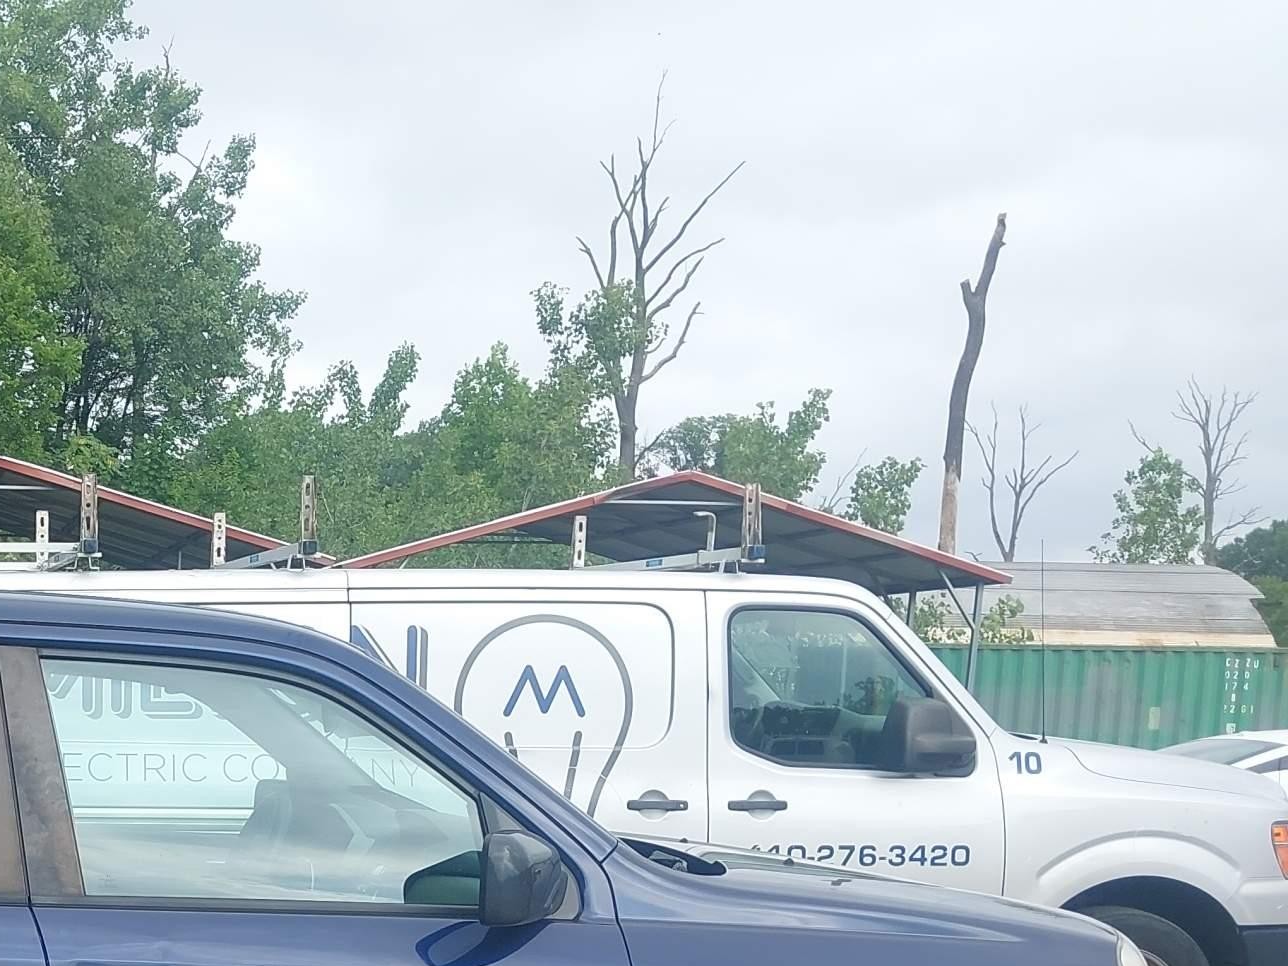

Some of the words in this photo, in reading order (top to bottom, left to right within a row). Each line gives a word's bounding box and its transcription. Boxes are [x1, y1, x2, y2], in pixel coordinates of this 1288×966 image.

[62, 752, 208, 783] ECTRIC
[1008, 751, 1042, 775] 10
[751, 844, 971, 867] 0-276-3420
